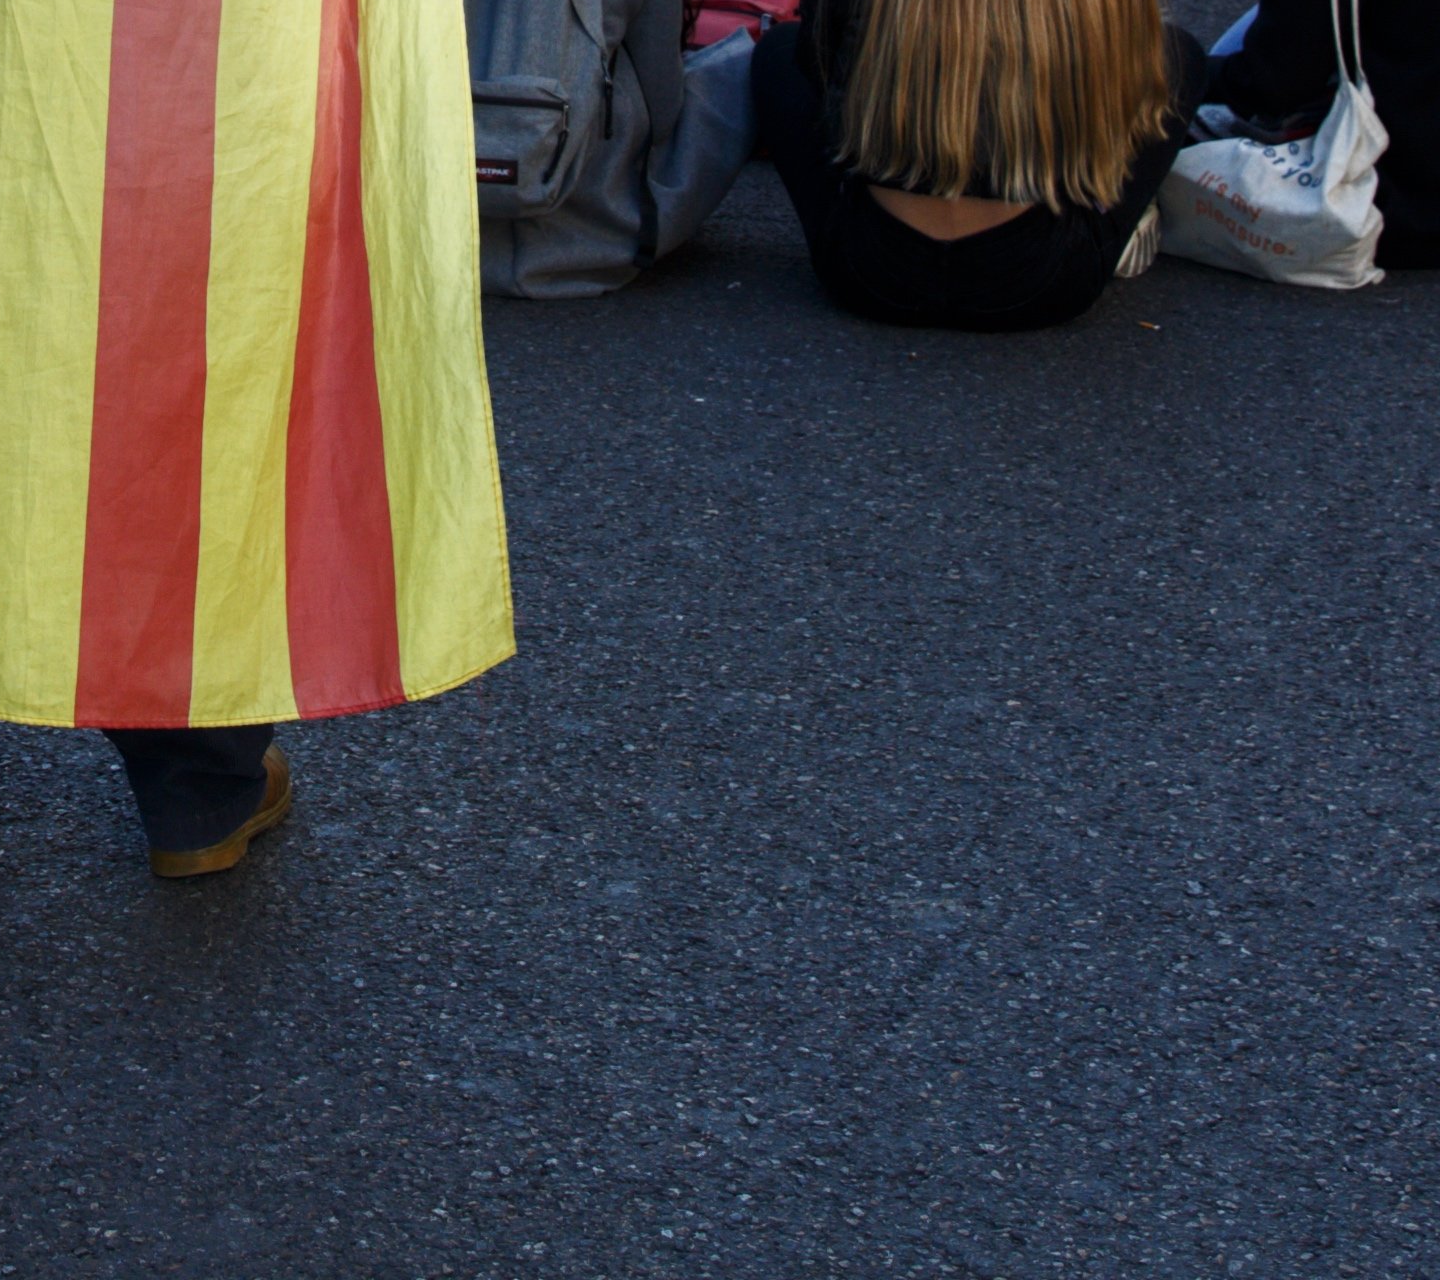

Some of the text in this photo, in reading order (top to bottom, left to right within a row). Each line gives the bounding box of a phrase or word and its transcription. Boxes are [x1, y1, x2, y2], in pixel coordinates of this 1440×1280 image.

[1196, 170, 1263, 223] It's my
[1196, 197, 1295, 256] pleasure.
